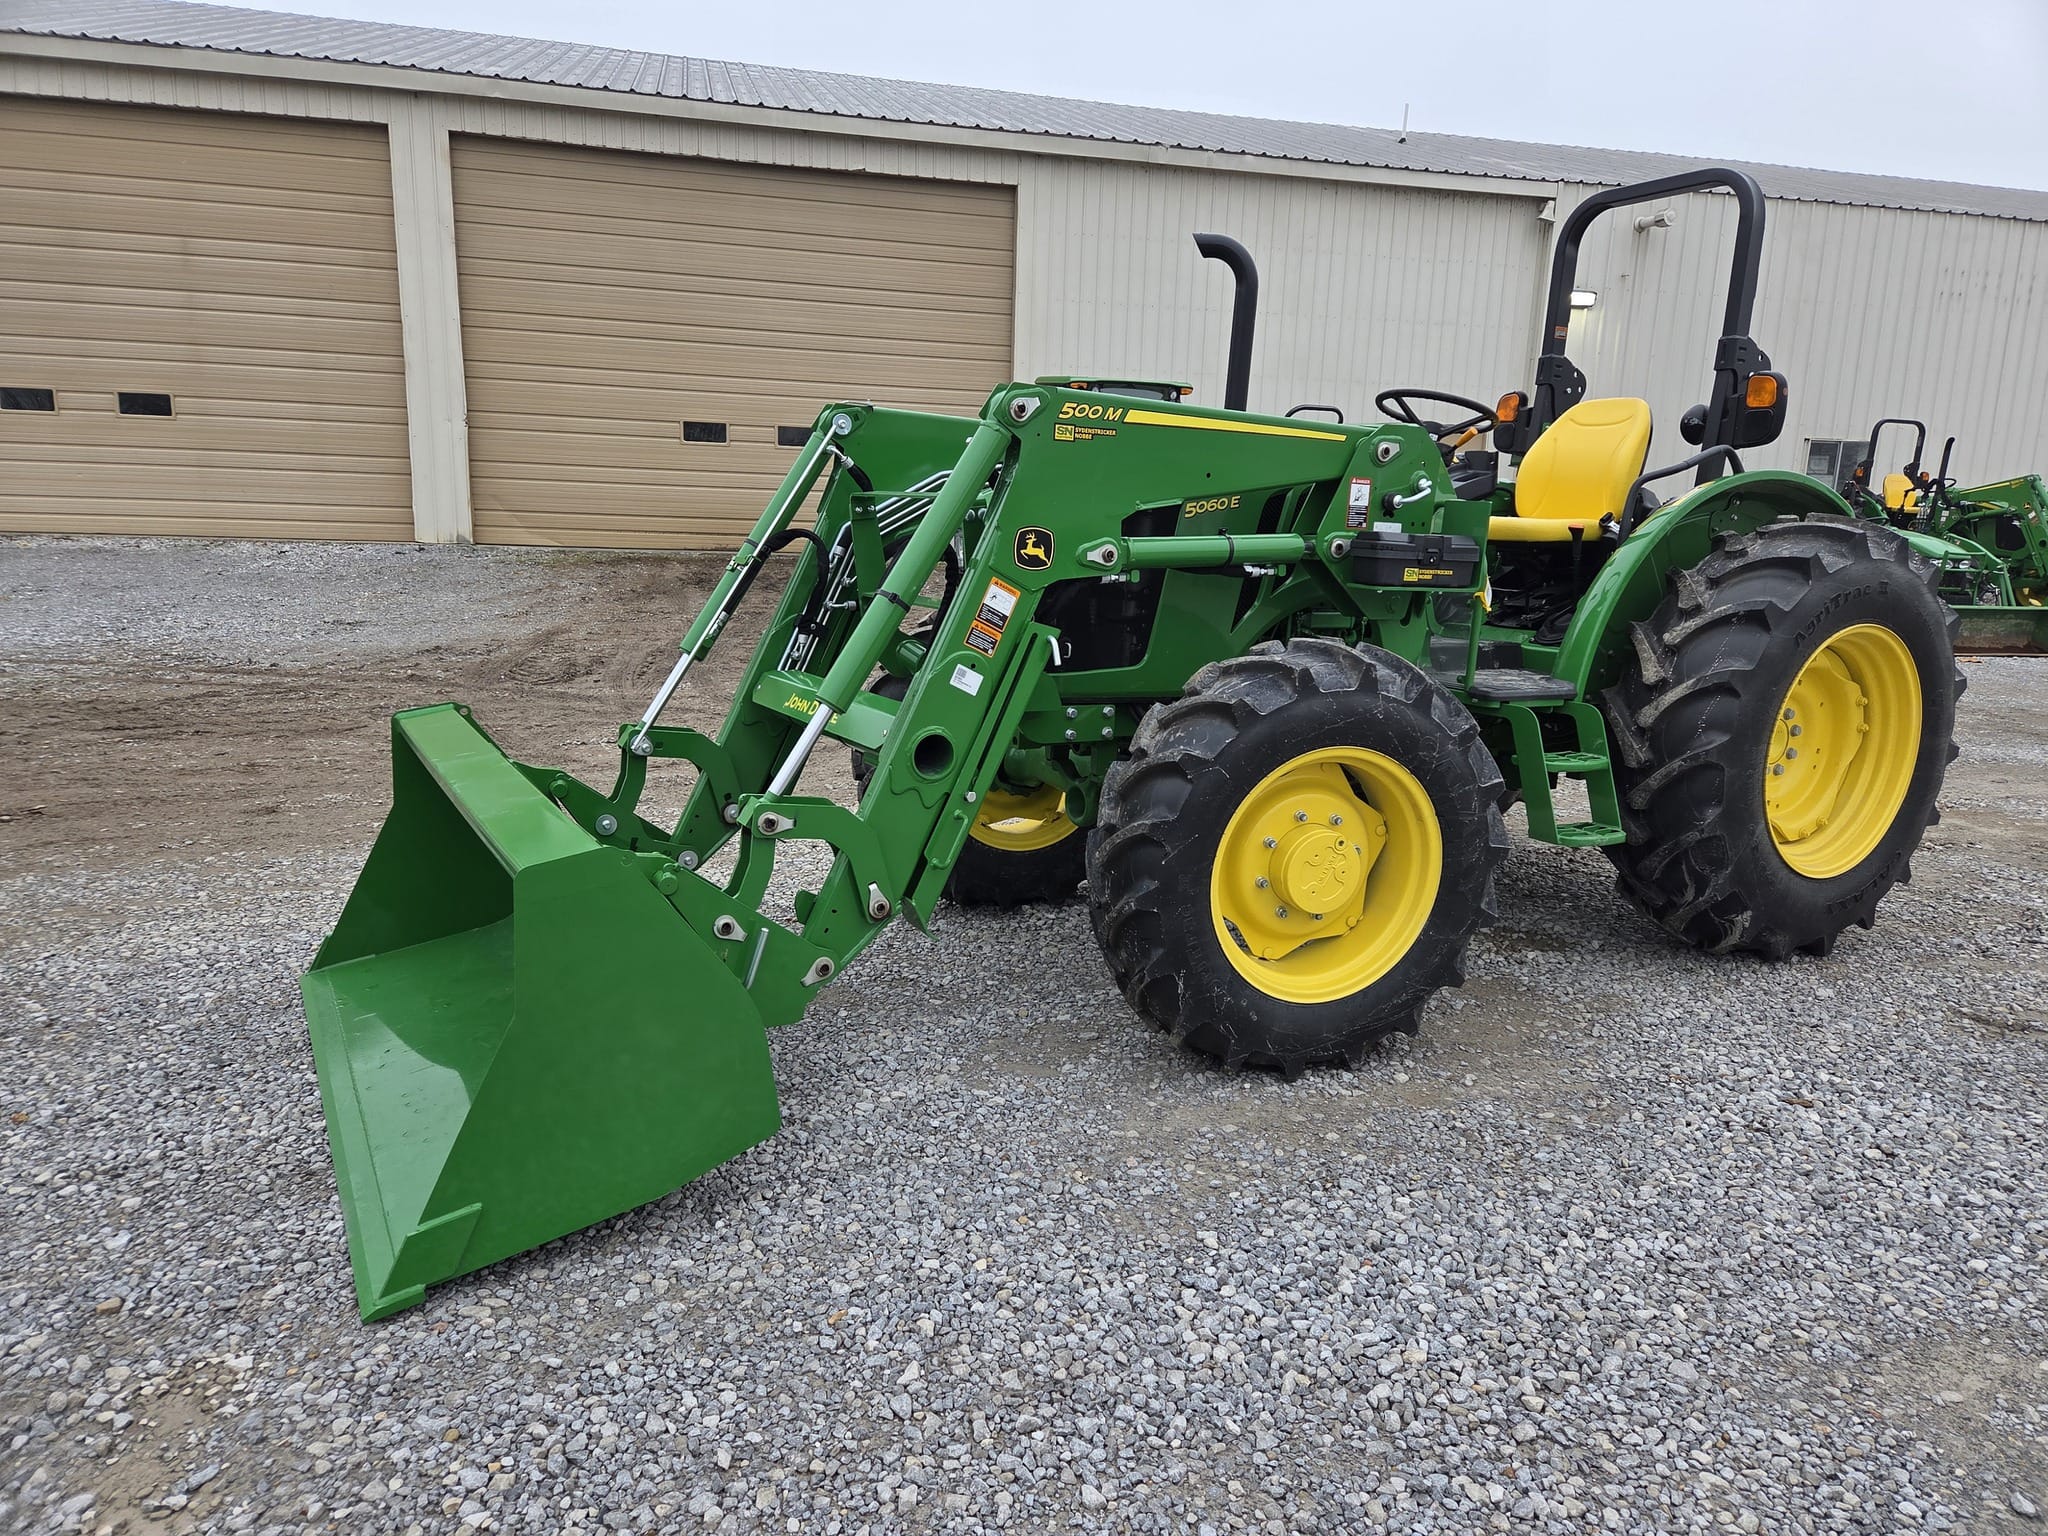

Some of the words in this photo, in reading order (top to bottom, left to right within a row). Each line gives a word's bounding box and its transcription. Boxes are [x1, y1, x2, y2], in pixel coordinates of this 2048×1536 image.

[1058, 402, 1104, 419] 500
[1103, 407, 1124, 421] M
[1184, 497, 1229, 518] 5060
[1230, 495, 1241, 508] E
